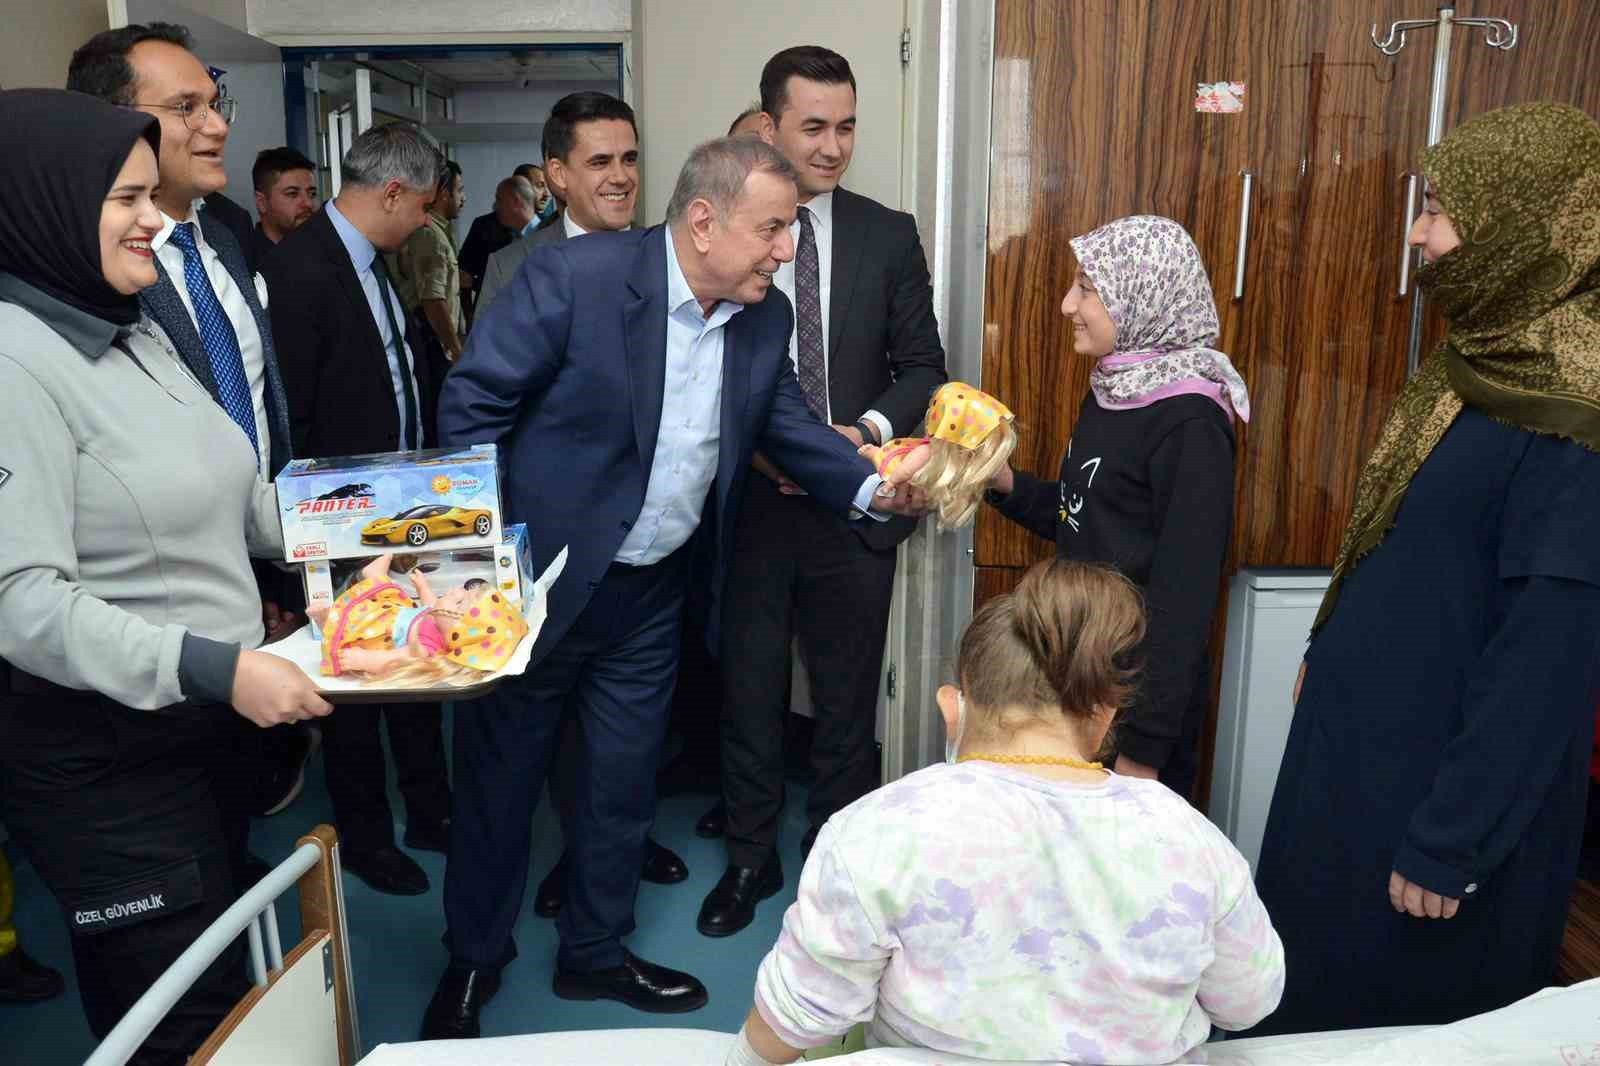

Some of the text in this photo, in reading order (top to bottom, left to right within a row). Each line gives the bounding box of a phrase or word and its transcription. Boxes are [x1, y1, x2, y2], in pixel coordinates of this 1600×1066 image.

[296, 497, 376, 514] PANTER
[75, 894, 165, 924] ÖZEL GÜVENLİK
